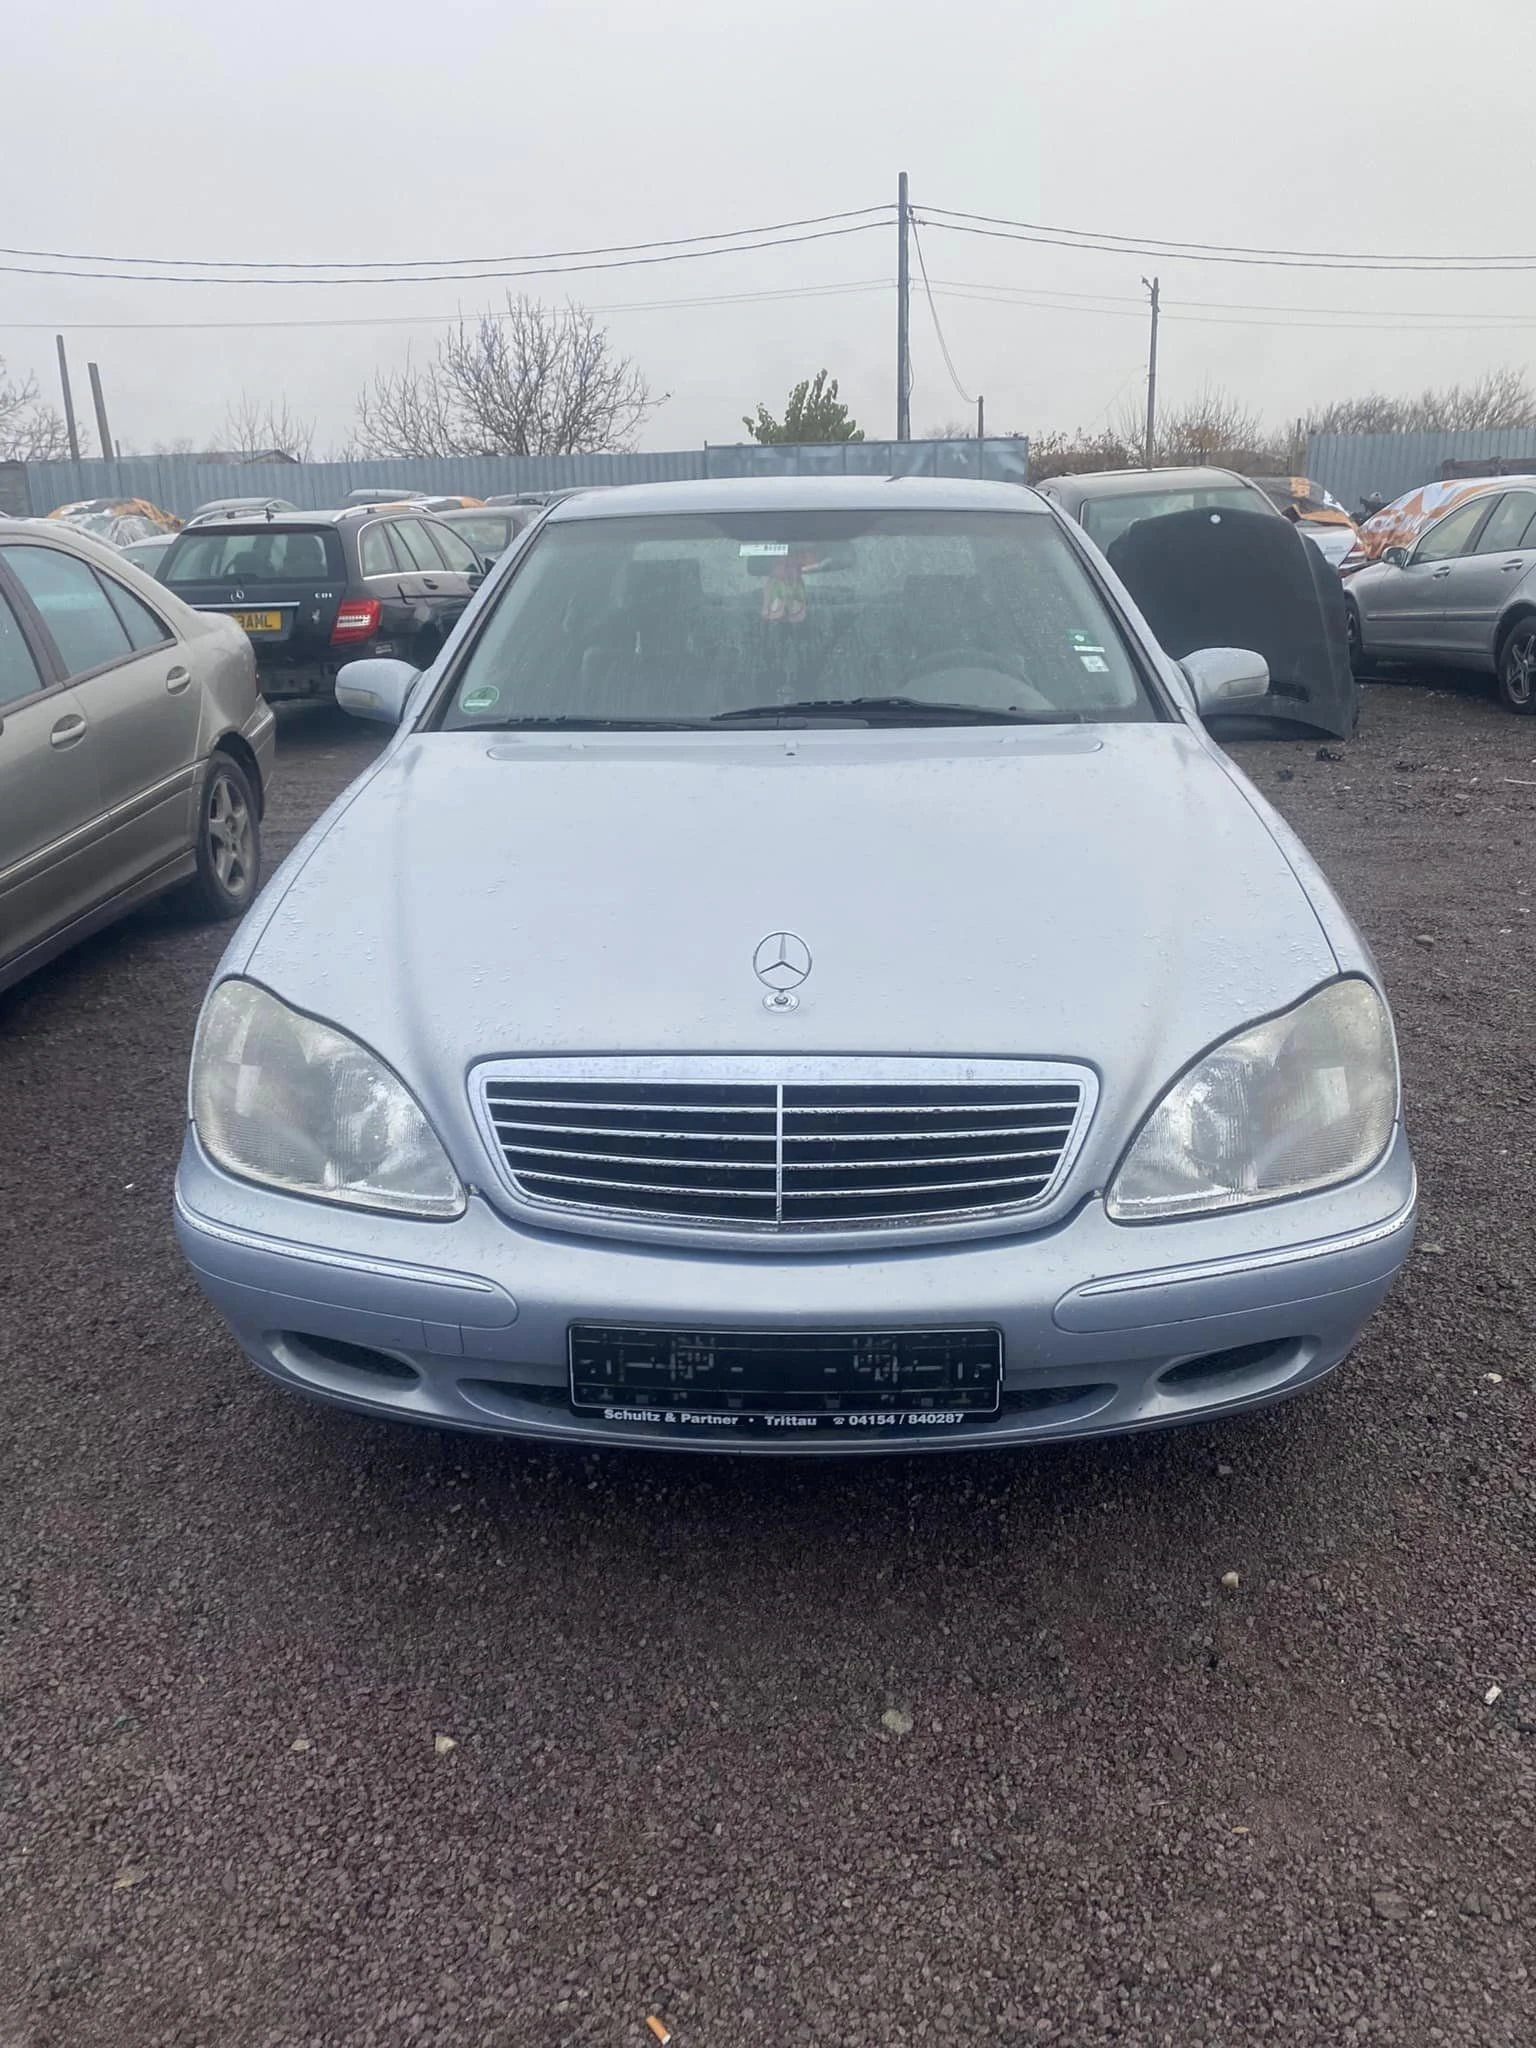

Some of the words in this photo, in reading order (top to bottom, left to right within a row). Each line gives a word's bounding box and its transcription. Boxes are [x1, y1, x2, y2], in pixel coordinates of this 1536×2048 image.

[603, 1408, 661, 1422] Schultz
[664, 1412, 677, 1423] &
[680, 1413, 739, 1425] Partner
[764, 1415, 817, 1426] Trittau
[849, 1414, 895, 1426] 04154
[907, 1413, 964, 1425] 840287
